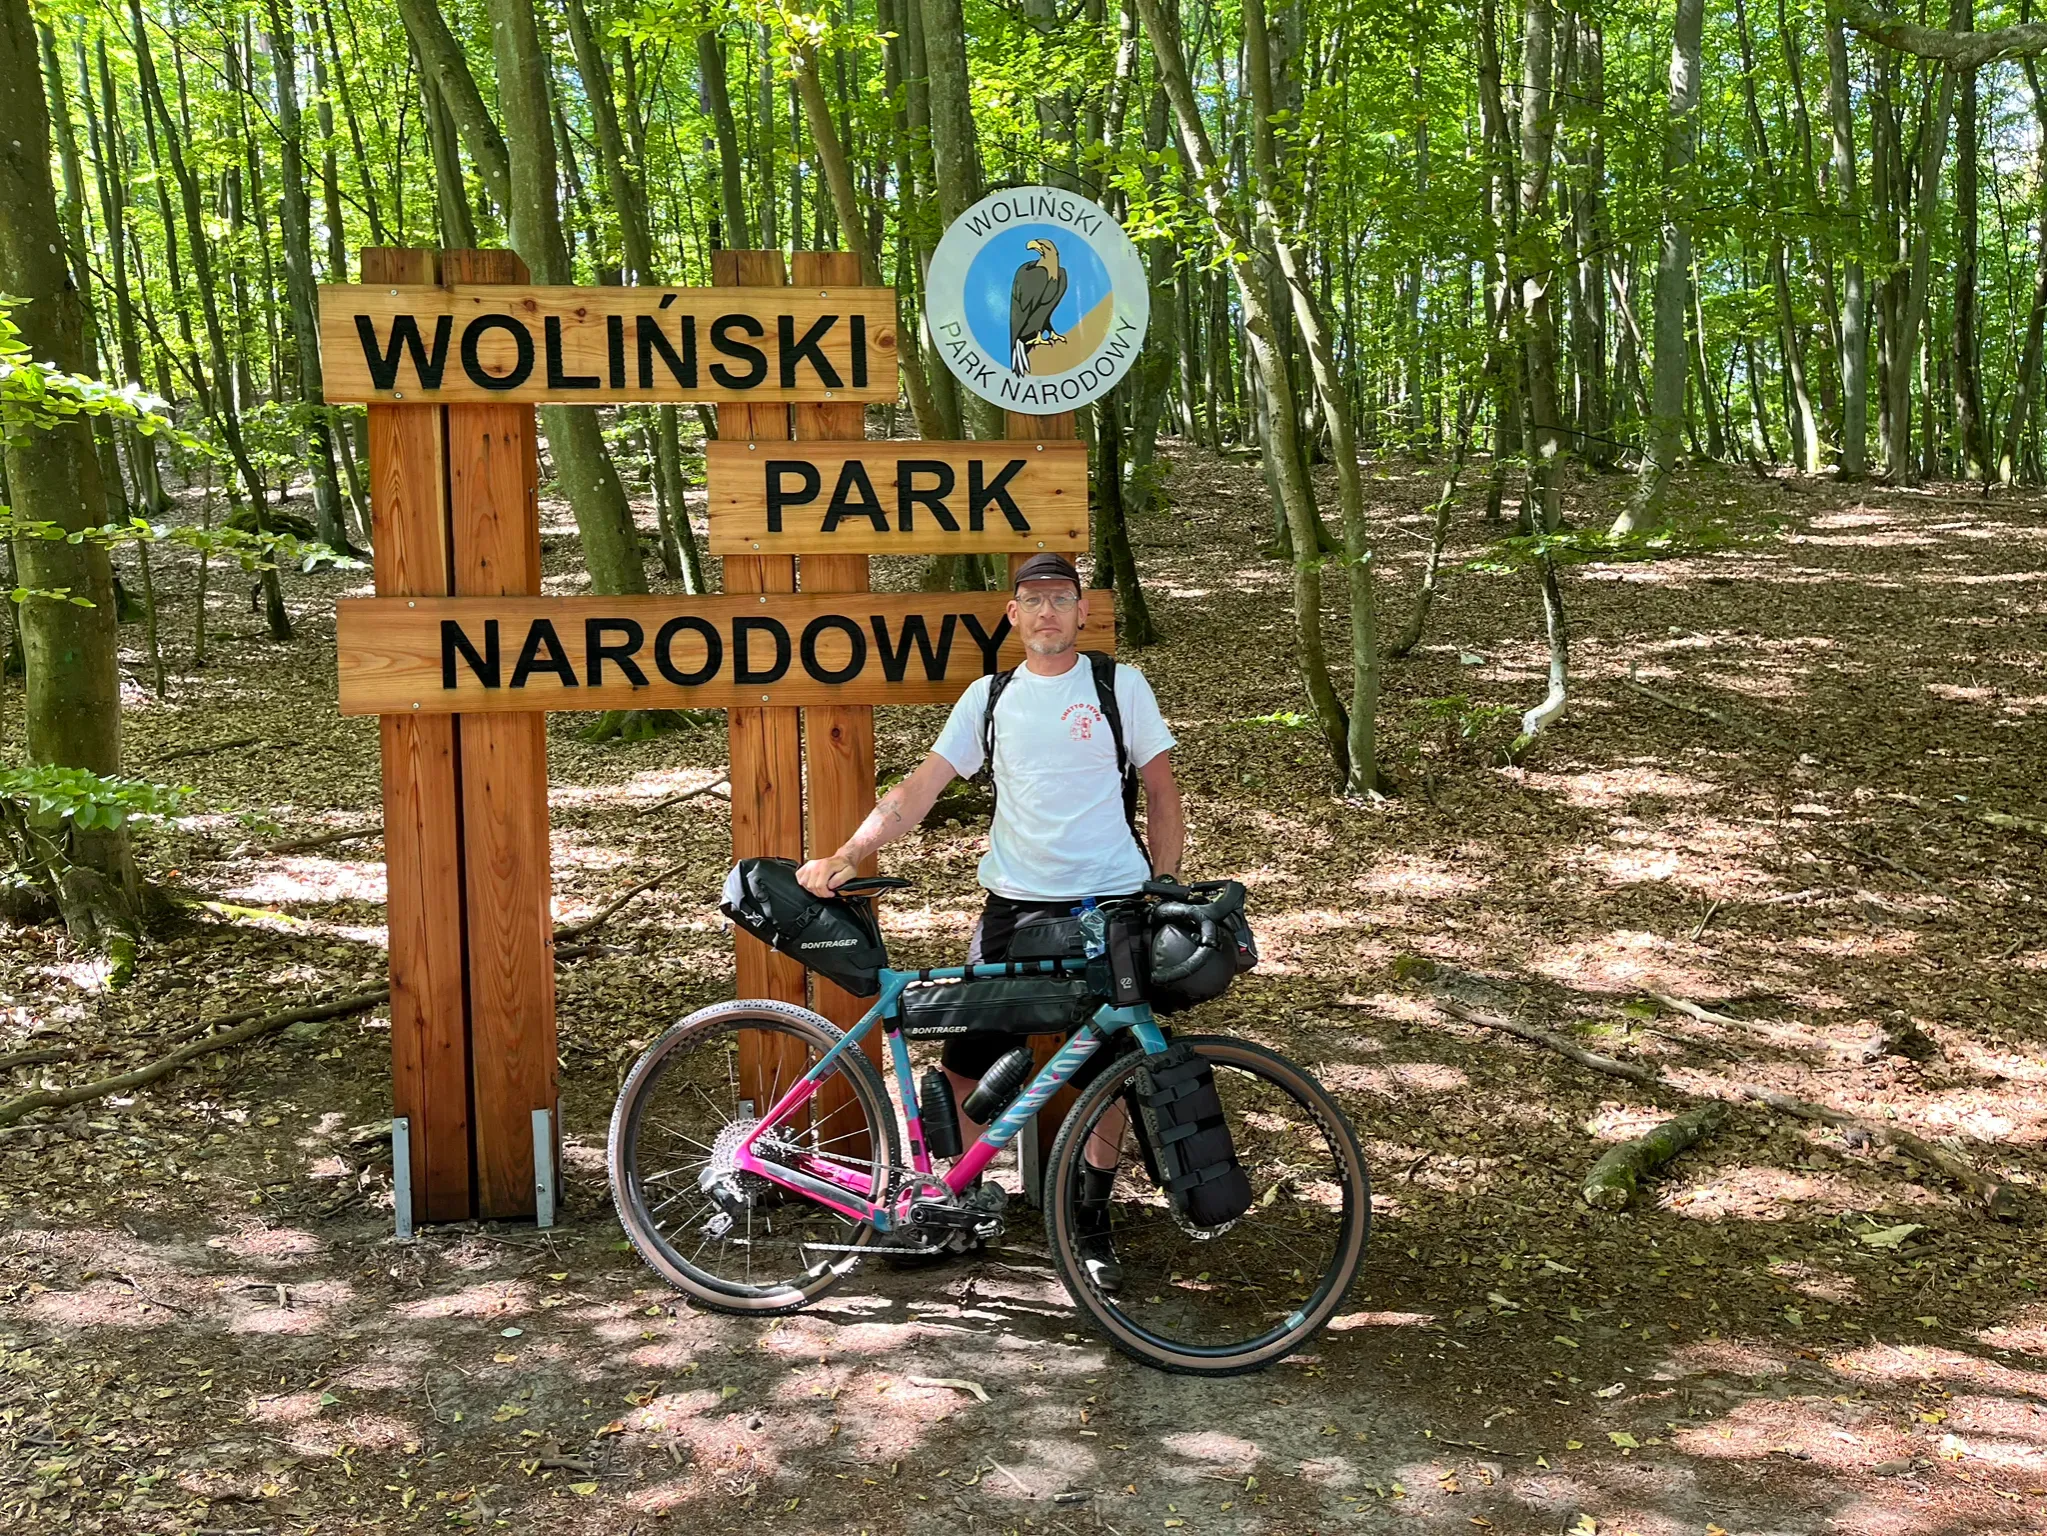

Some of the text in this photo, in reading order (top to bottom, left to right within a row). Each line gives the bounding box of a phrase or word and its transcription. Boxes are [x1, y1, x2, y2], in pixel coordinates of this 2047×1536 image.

[965, 187, 1103, 238] WOLIŃSKI
[354, 294, 868, 390] WOLIŃSKI
[939, 316, 1137, 405] PARK NARODOWY
[765, 459, 1031, 532] PARK
[440, 614, 1013, 688] NARODOWY
[800, 938, 858, 950] BONTRAGER
[911, 1026, 968, 1035] BONTRAGER
[986, 1039, 1100, 1141] CANYON
